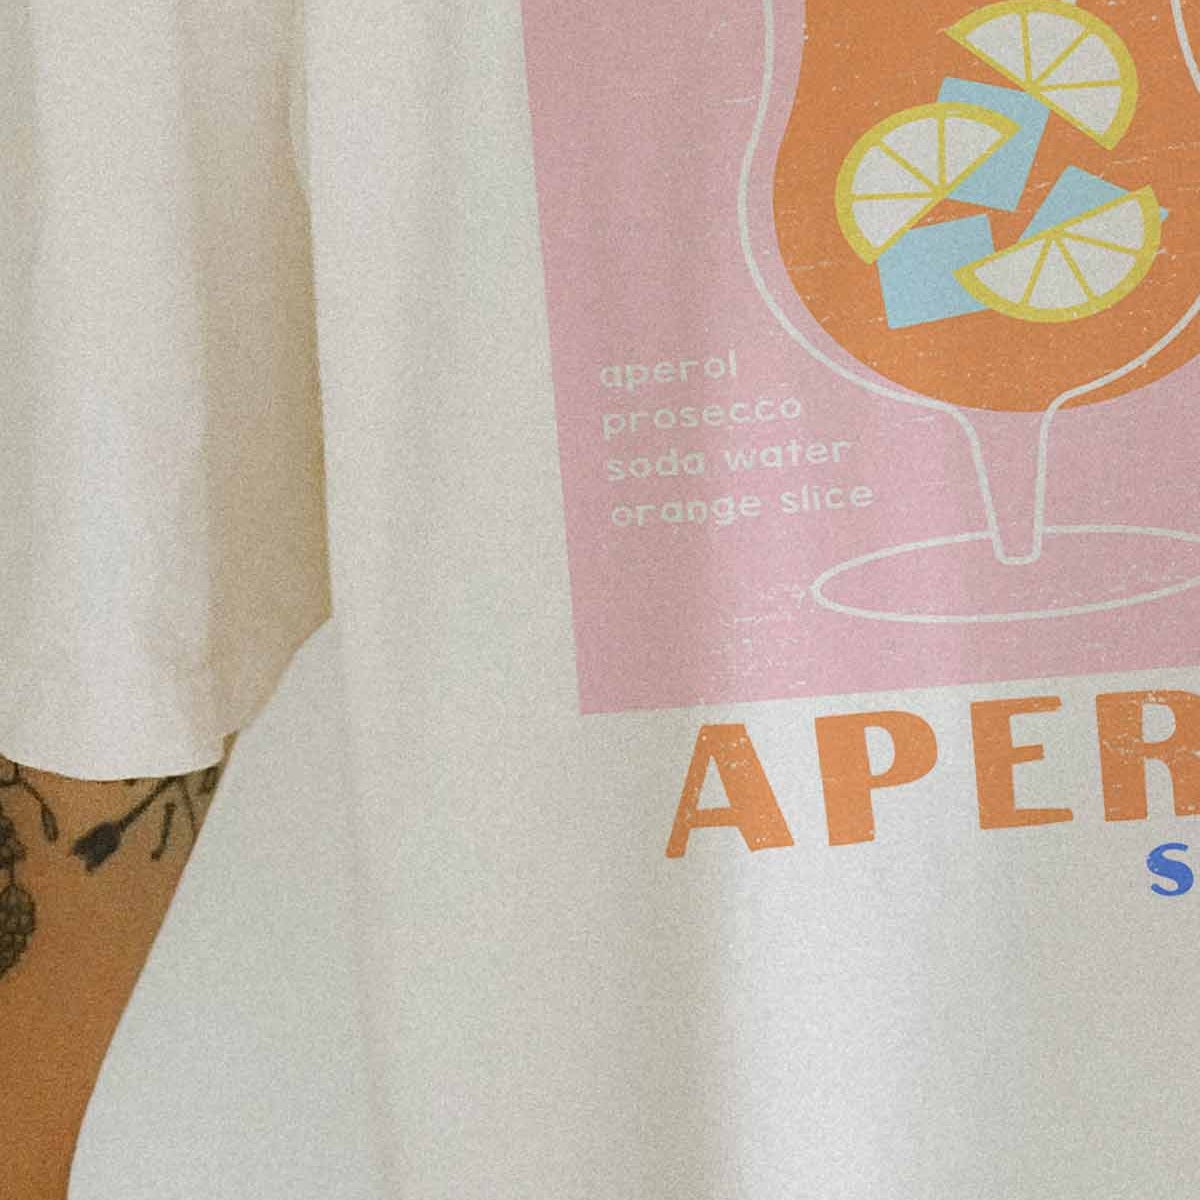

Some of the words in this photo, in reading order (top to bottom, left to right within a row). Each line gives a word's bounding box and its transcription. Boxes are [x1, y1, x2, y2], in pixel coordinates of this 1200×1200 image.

[601, 349, 737, 391] aperol
[602, 397, 802, 440] prosecco
[606, 450, 705, 481] soda
[724, 439, 851, 471] water
[611, 494, 761, 526] orange
[780, 484, 875, 514] slice
